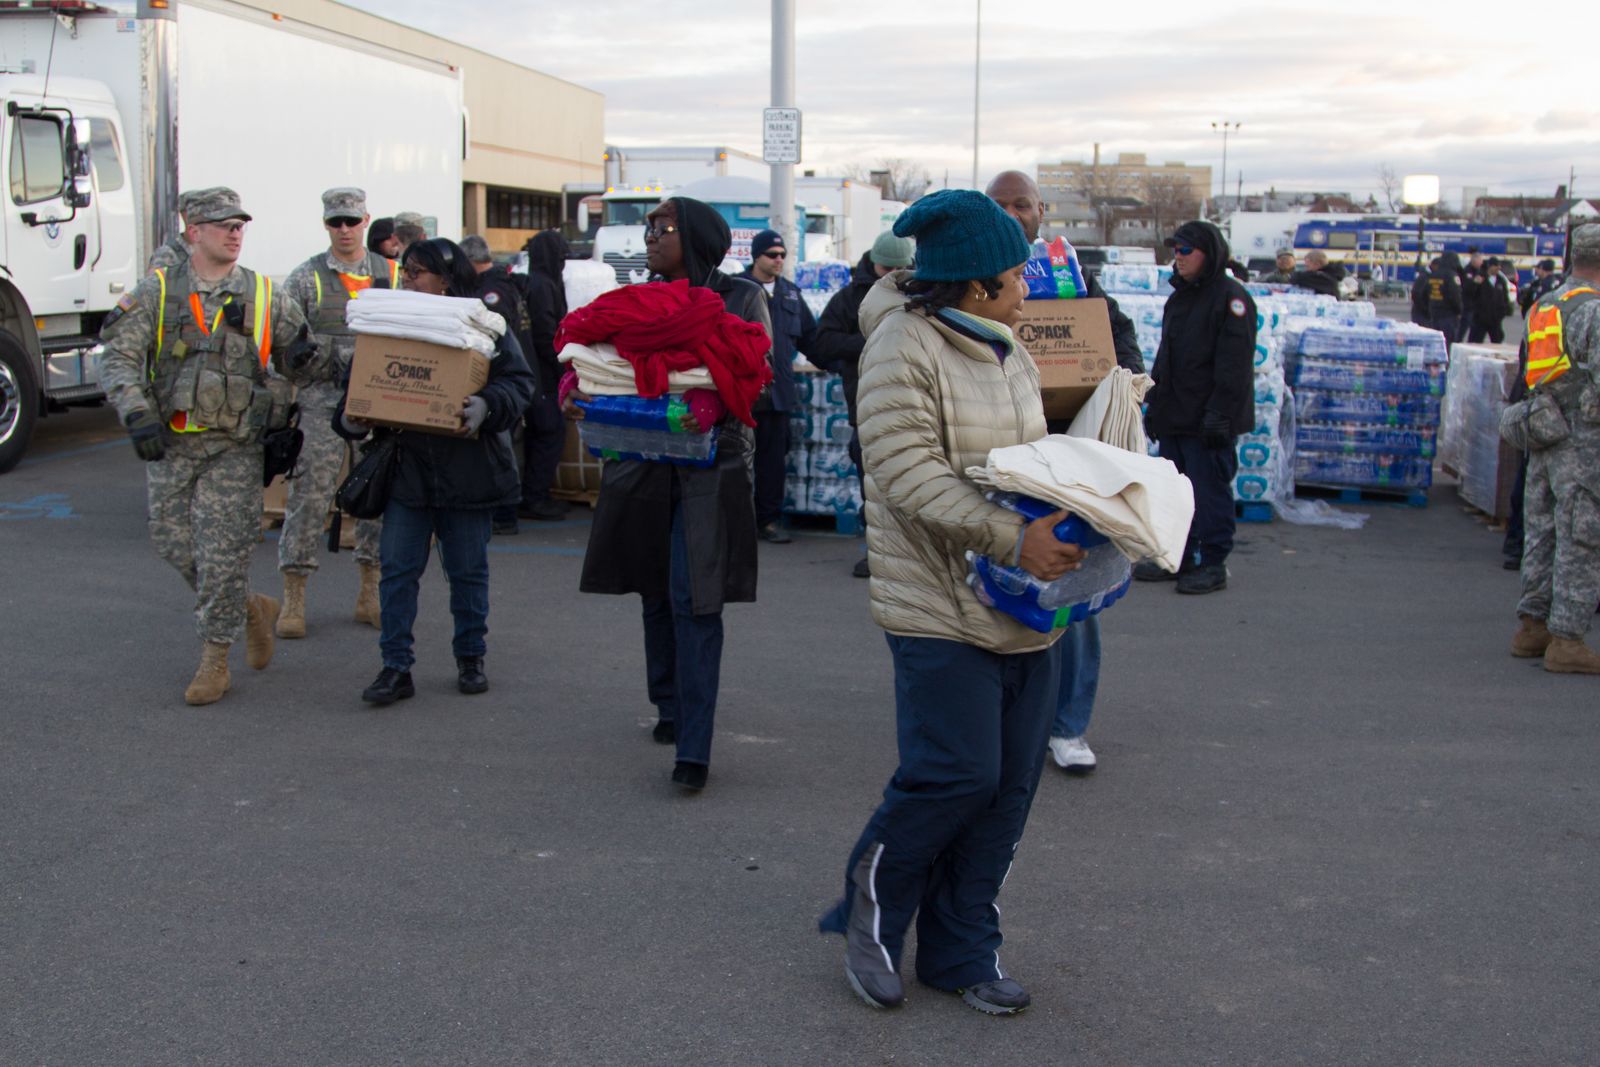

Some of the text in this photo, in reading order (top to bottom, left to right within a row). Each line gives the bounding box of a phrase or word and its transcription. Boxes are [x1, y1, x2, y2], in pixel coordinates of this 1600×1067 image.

[766, 112, 796, 120] CUSTOMER
[768, 123, 793, 131] PARKING
[733, 231, 757, 239] FLUS
[1052, 255, 1065, 264] 24
[1054, 340, 1091, 351] Meal
[370, 375, 410, 393] Ready
[412, 381, 444, 392] Meal
